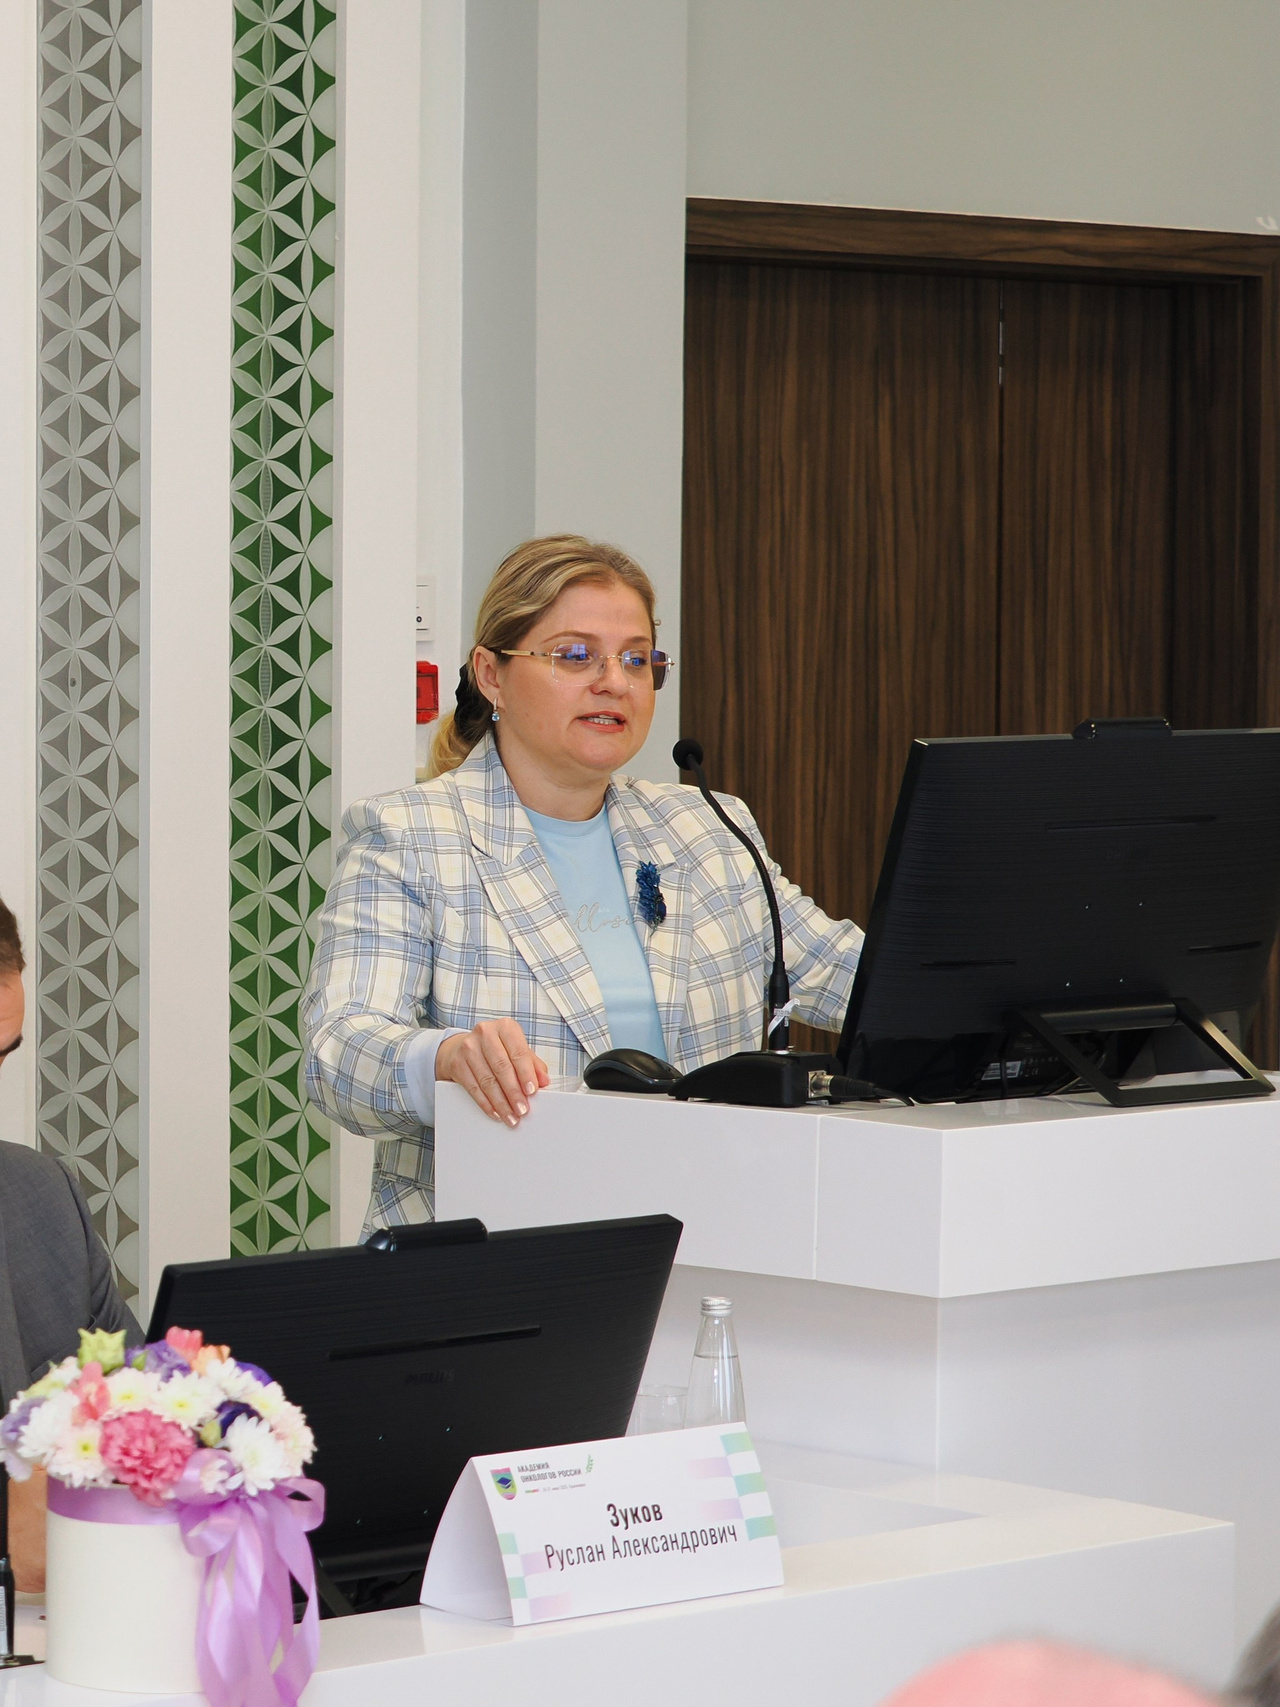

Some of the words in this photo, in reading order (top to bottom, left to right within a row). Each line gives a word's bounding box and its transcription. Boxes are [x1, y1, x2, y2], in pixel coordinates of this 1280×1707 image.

[517, 1462, 551, 1473] АКАДЕМИЯ
[520, 1471, 557, 1483] ОНКОЛОГОВ
[558, 1468, 583, 1478] РОССИИ
[606, 1502, 664, 1530] Зуков
[544, 1541, 607, 1572] Руслан
[611, 1522, 739, 1560] Александрович
